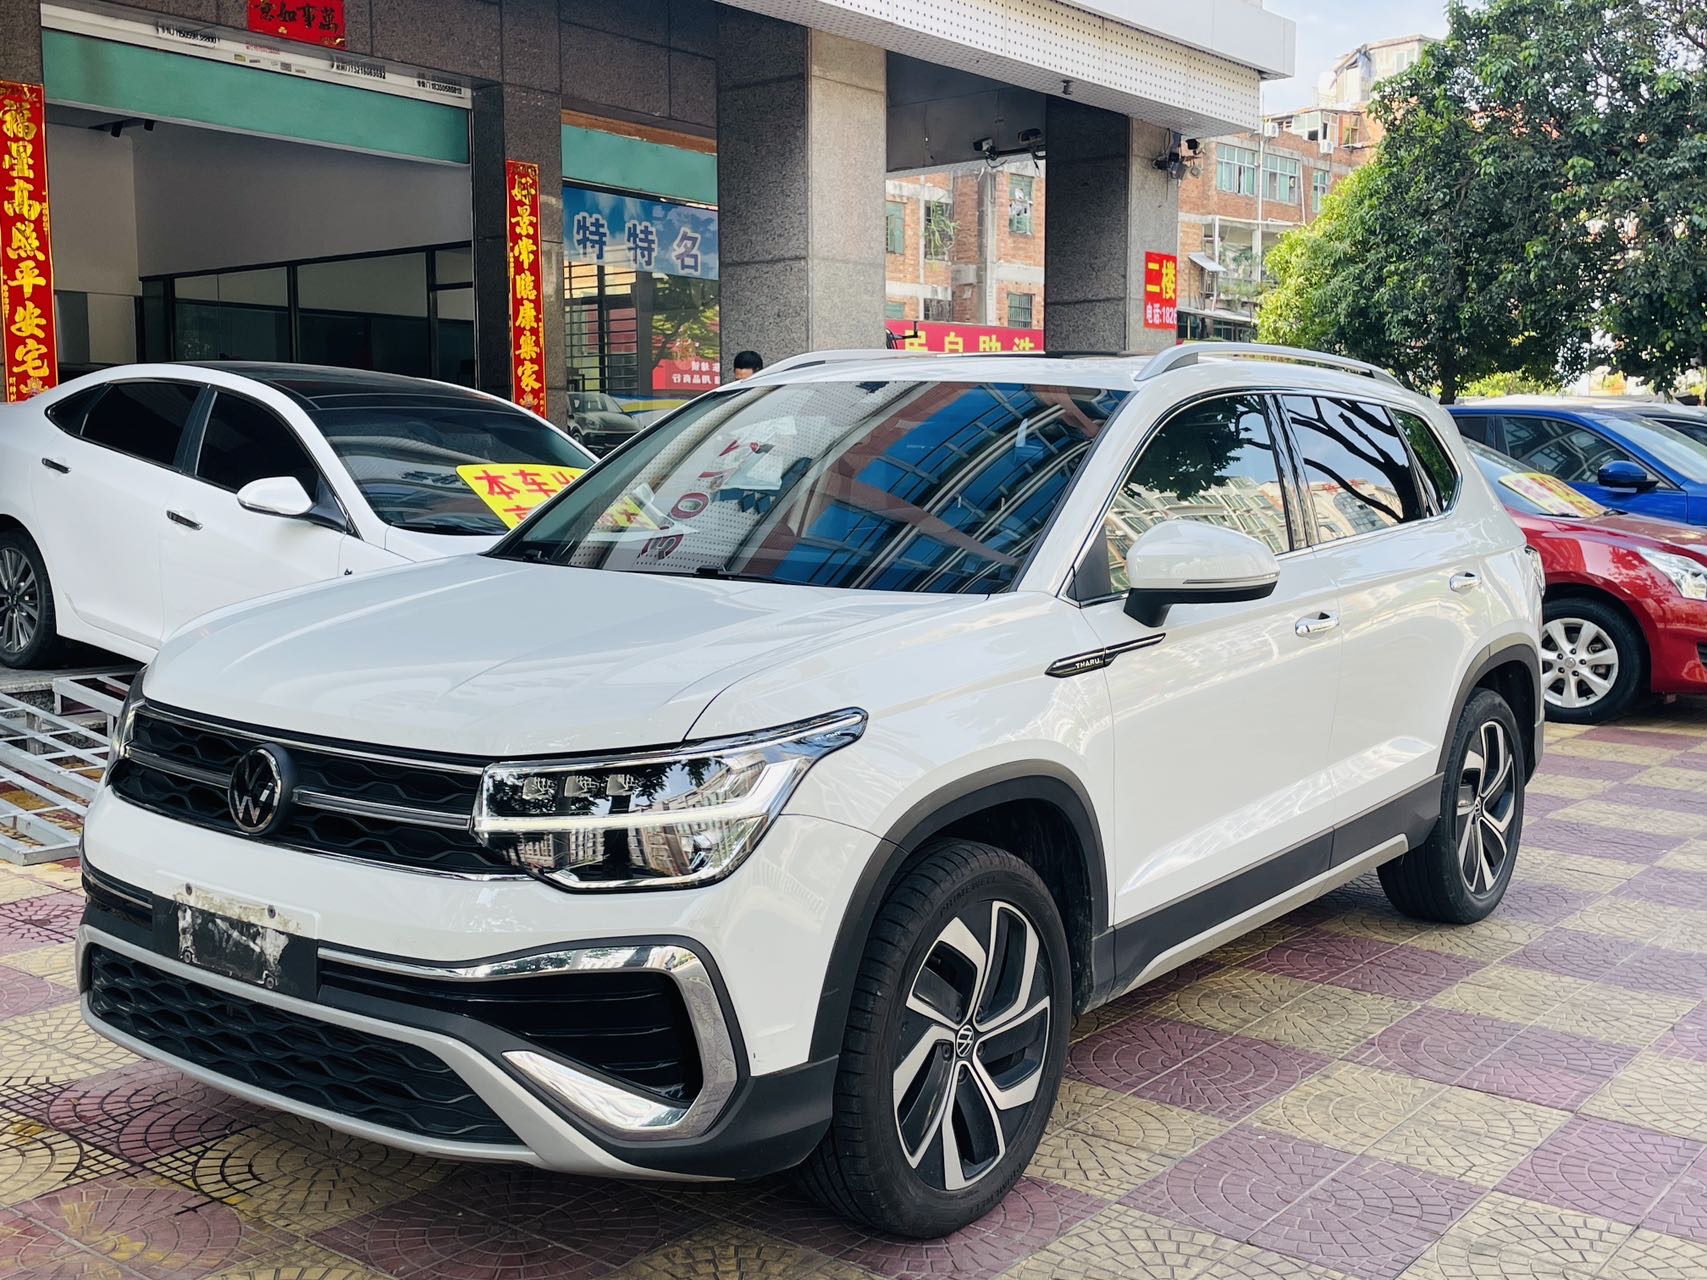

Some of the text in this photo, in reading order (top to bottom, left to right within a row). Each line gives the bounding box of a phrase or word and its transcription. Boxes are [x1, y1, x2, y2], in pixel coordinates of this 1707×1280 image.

[574, 213, 701, 274] 特特名
[1146, 259, 1176, 300] 二楼
[1075, 658, 1100, 669] THARU
